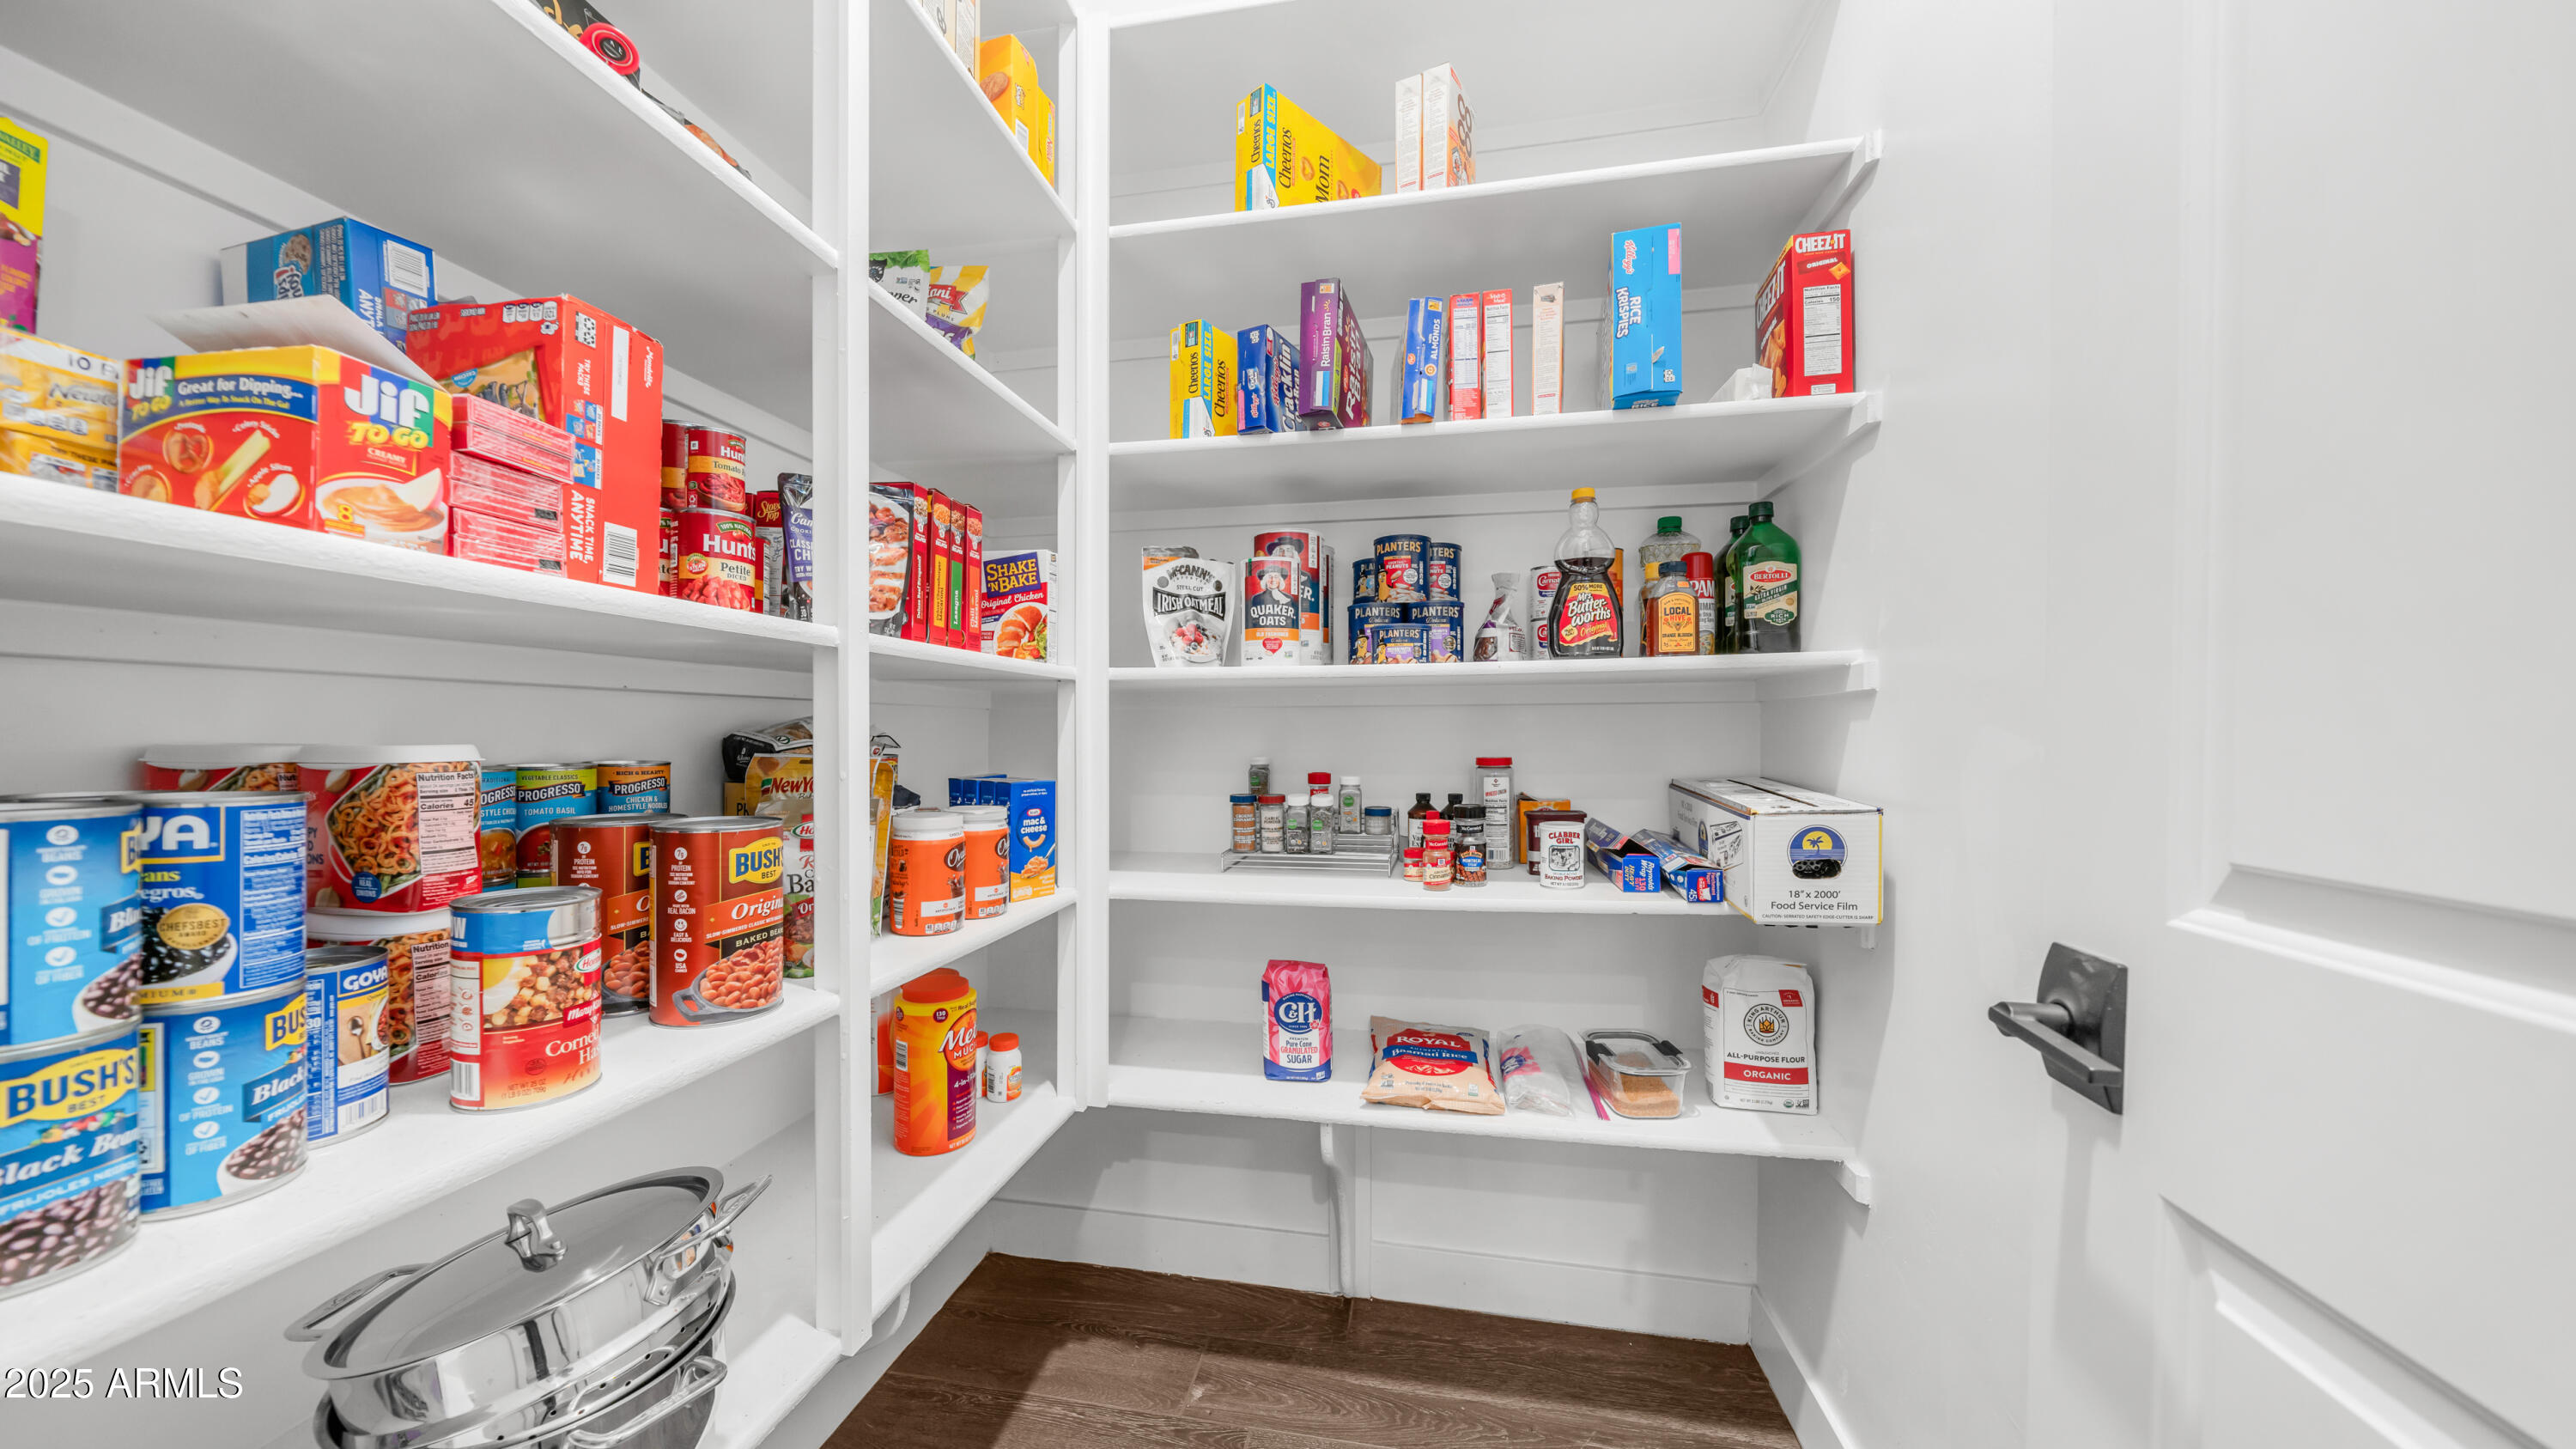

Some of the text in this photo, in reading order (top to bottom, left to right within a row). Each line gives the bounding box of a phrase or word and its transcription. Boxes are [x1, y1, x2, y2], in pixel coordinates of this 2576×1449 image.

[1251, 119, 1261, 163] Cheerios
[1266, 126, 1275, 168] LARGE
[1279, 127, 1291, 188] Cheerios
[1315, 155, 1329, 203] Mom
[1795, 234, 1845, 253] CHEEZ-IT
[1623, 240, 1637, 275] Kellogg's
[1616, 286, 1629, 338] KRISPIES
[1630, 295, 1641, 325] RICE
[1431, 319, 1441, 360] ALMONDS
[1188, 352, 1198, 393] Cheerios
[129, 365, 173, 399] Jif
[178, 381, 214, 395] Great
[216, 378, 237, 392] for
[1215, 360, 1225, 417] Cheerios
[343, 374, 430, 429] Jif
[349, 422, 429, 449] TO GO
[368, 447, 406, 464] CREAMY
[712, 460, 741, 473] Tomato
[337, 504, 354, 522] 8
[766, 511, 780, 522] Top
[570, 490, 585, 561] ANYTIME
[582, 497, 595, 564] SNACK TIME,
[734, 524, 752, 536] NATURAL
[1376, 541, 1421, 556] PLANTERS
[720, 563, 750, 575] Petite
[986, 558, 1037, 581] SHAKE
[999, 574, 1038, 593] BAKE
[1539, 575, 1560, 586] Carnat
[1771, 585, 1787, 595] VIRGIN
[981, 591, 1044, 609] Original Chicken
[1157, 594, 1224, 617] IRISH OATMEAL
[1568, 598, 1607, 617] Butter-
[1250, 606, 1294, 618] QUAKER
[1355, 607, 1400, 619] PLANTERS
[1413, 607, 1458, 618] PLANTERS
[1664, 606, 1692, 616] LOCAL
[1260, 617, 1286, 626] OATS
[1379, 630, 1419, 639] PLANTERS
[518, 783, 580, 801] PROGRESSO
[615, 777, 665, 794] PROGRESSO
[464, 799, 474, 807] 45
[525, 807, 554, 816] TOMATO
[609, 803, 646, 813] HOMESTYLE
[1023, 818, 1038, 826] mac
[580, 843, 587, 852] 7g
[677, 849, 684, 859] 7g
[761, 870, 776, 880] BEST
[1646, 861, 1655, 891] Reynolds
[1689, 889, 1698, 899] 45
[159, 918, 226, 932] CHEFSBEST
[706, 919, 765, 939] SLOW-SIMMERED CLASSIC
[736, 927, 783, 947] BAKED BEAN
[412, 941, 449, 953] Nutrition
[343, 965, 387, 991] GOYA
[416, 970, 448, 980] Calories
[1279, 1002, 1316, 1023] C&H
[1747, 1007, 1785, 1024] KING ARTHUR
[190, 1038, 225, 1050] BEANS
[545, 1022, 599, 1056] Corned
[1397, 1036, 1461, 1047] ROYAL
[1287, 1055, 1312, 1063] SUGAR
[1727, 1052, 1780, 1063] ALL-PURPOSE
[1743, 1069, 1791, 1081] ORGANIC
[8, 1054, 134, 1118] BUSH'S
[68, 1095, 106, 1113] BEST
[192, 1105, 234, 1120] PROTEIN
[199, 1141, 227, 1154] FIBER
